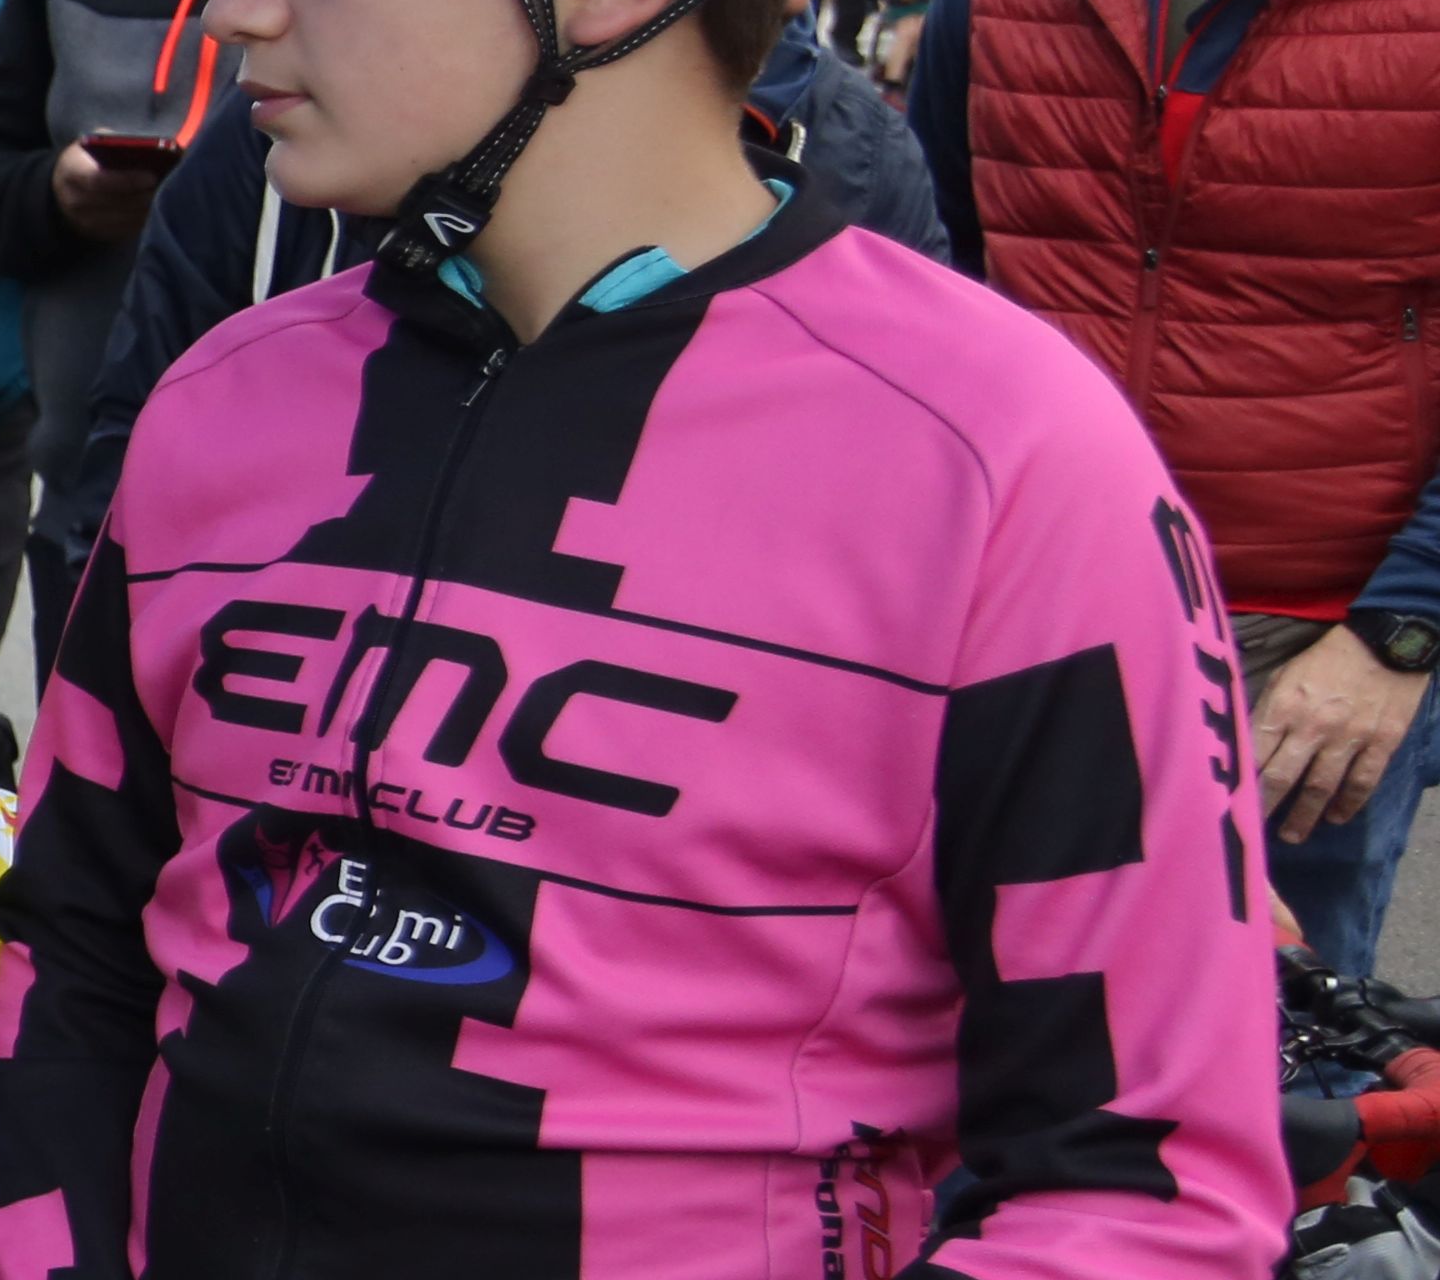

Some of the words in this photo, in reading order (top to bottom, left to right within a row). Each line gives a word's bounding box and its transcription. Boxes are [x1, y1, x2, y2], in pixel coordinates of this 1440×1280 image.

[191, 598, 739, 818] EMC
[368, 780, 538, 842] CLUB
[309, 893, 415, 967] Cub
